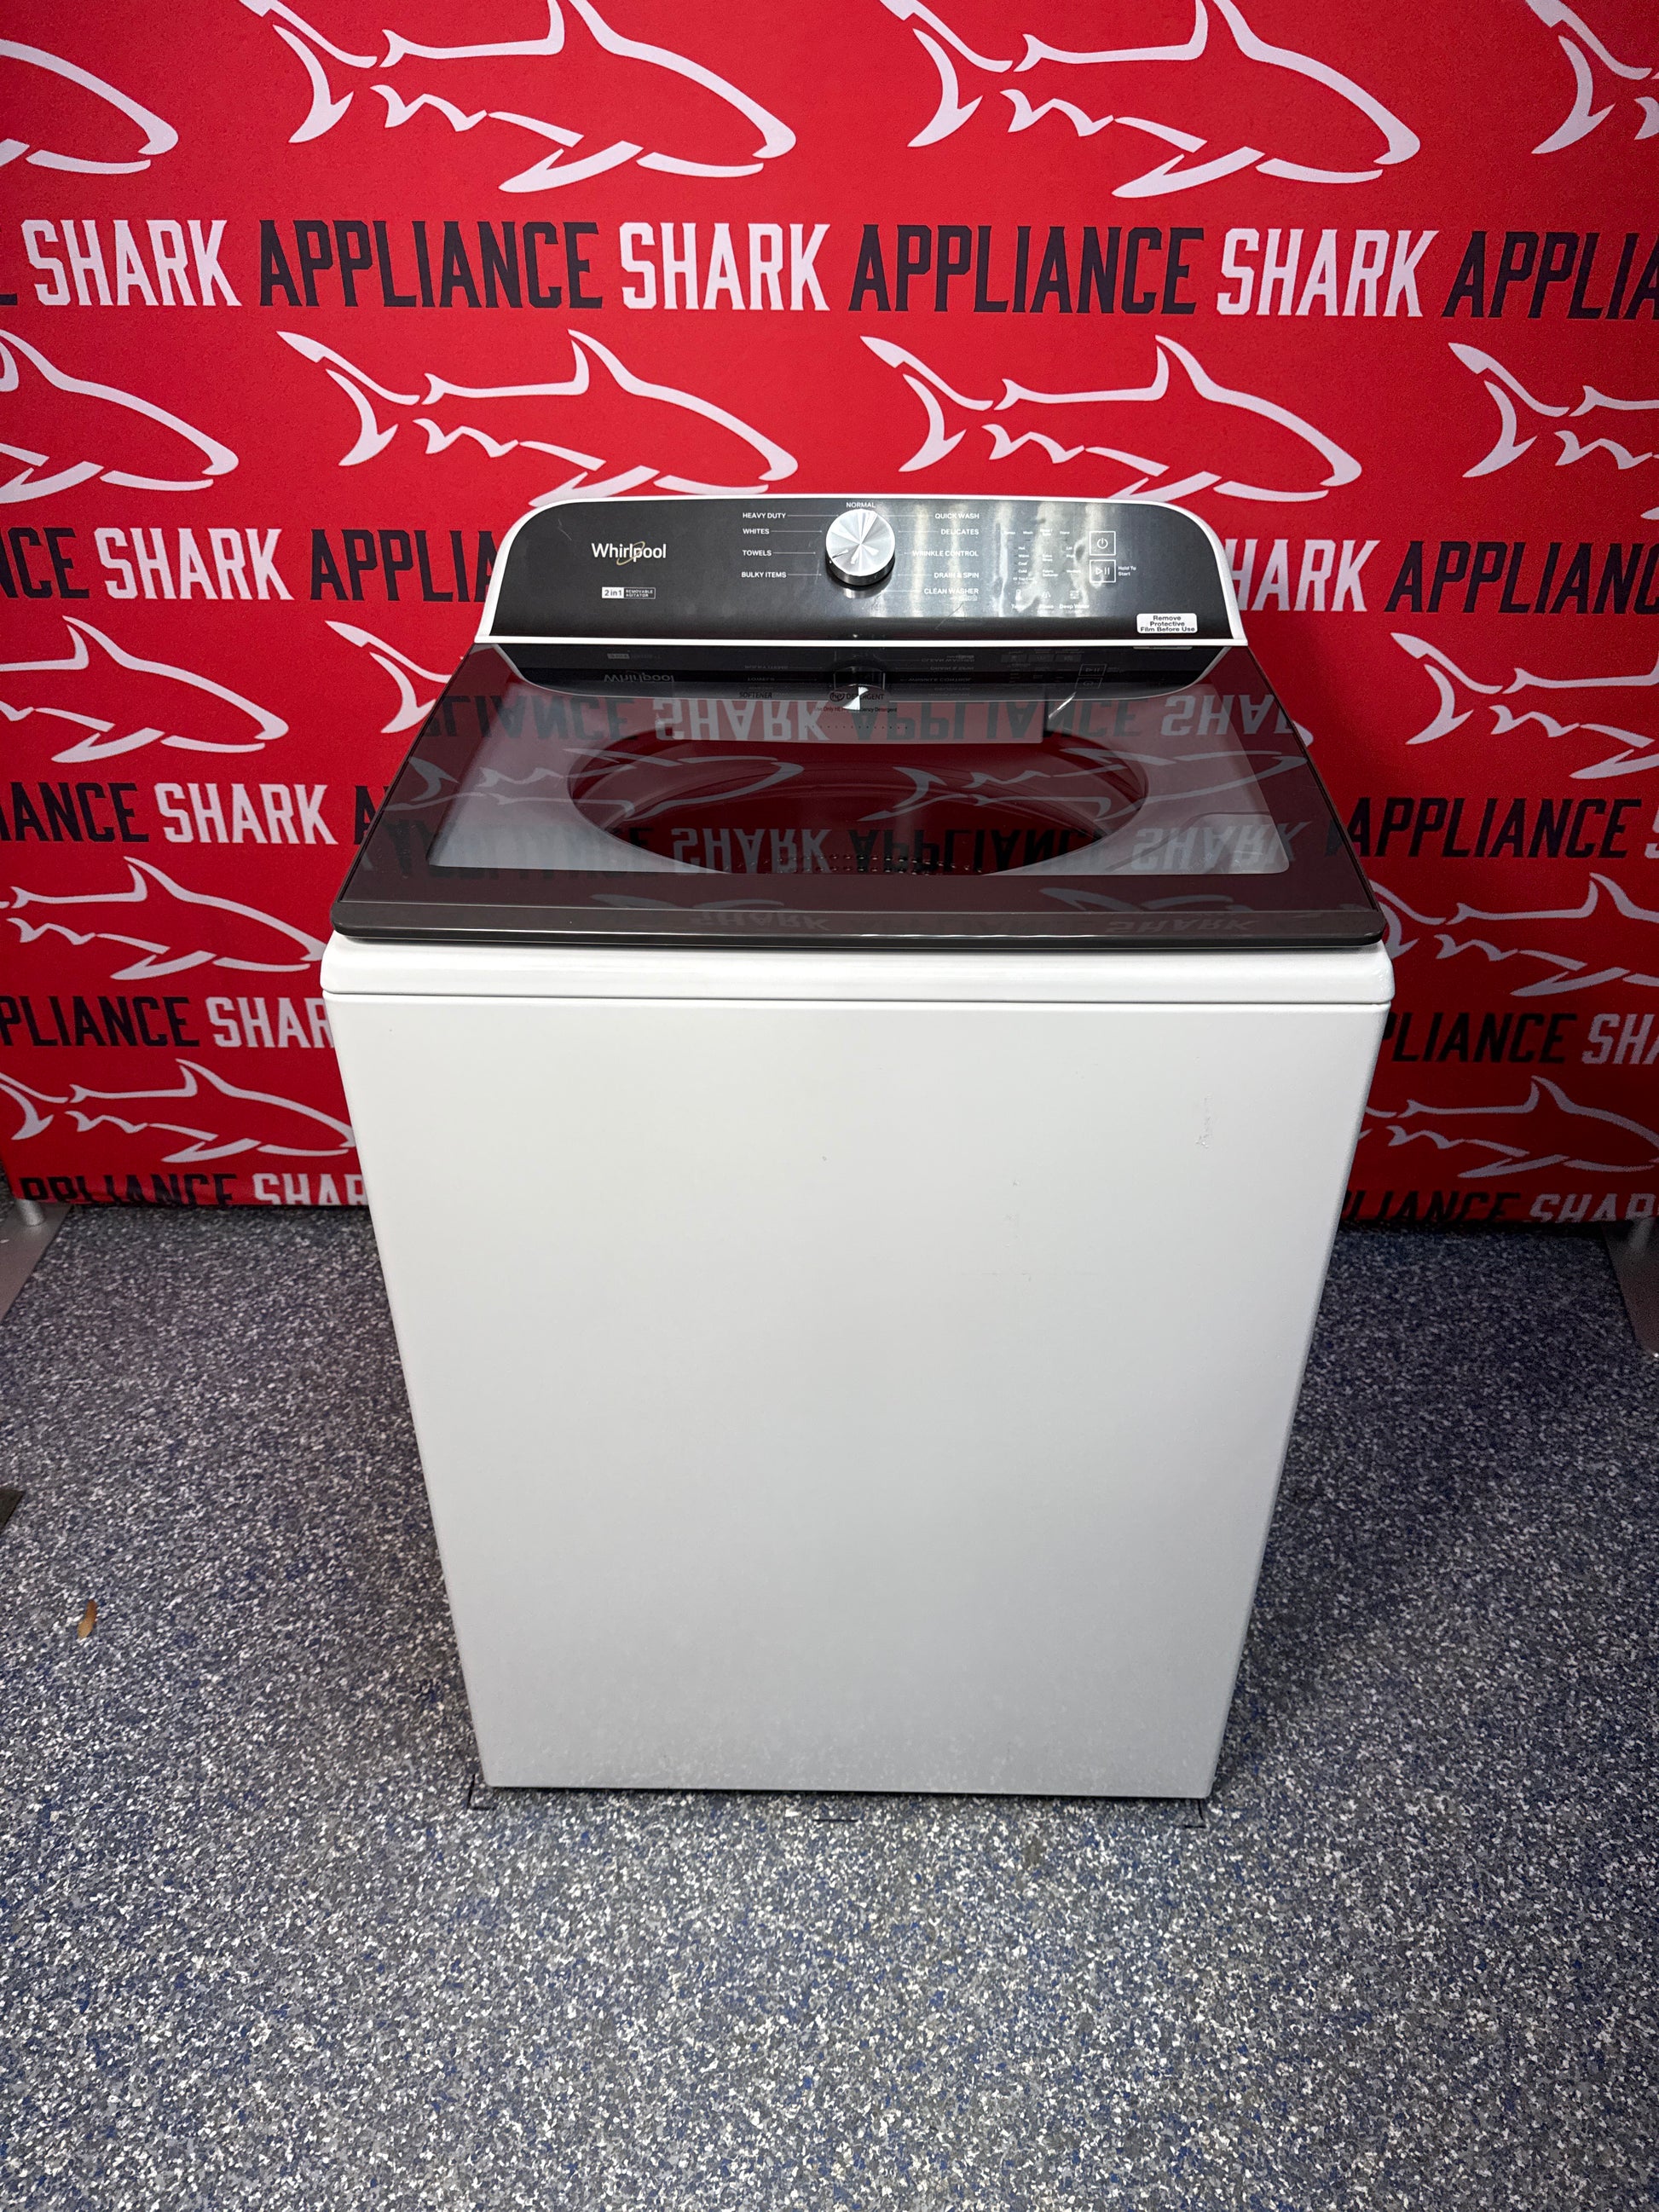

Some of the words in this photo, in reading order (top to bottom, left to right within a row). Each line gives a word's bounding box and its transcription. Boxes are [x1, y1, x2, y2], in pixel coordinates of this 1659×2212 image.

[20, 219, 242, 307] SHARK
[259, 219, 603, 309] APPLIANCE
[619, 222, 831, 311] SHARK
[847, 223, 1204, 315] APPLIANCE
[1217, 228, 1439, 318] SHARK
[94, 528, 294, 600] SHARK
[591, 543, 667, 563] Whirlpool
[154, 783, 338, 845] SHARK
[1347, 797, 1642, 859] APPLIANCE
